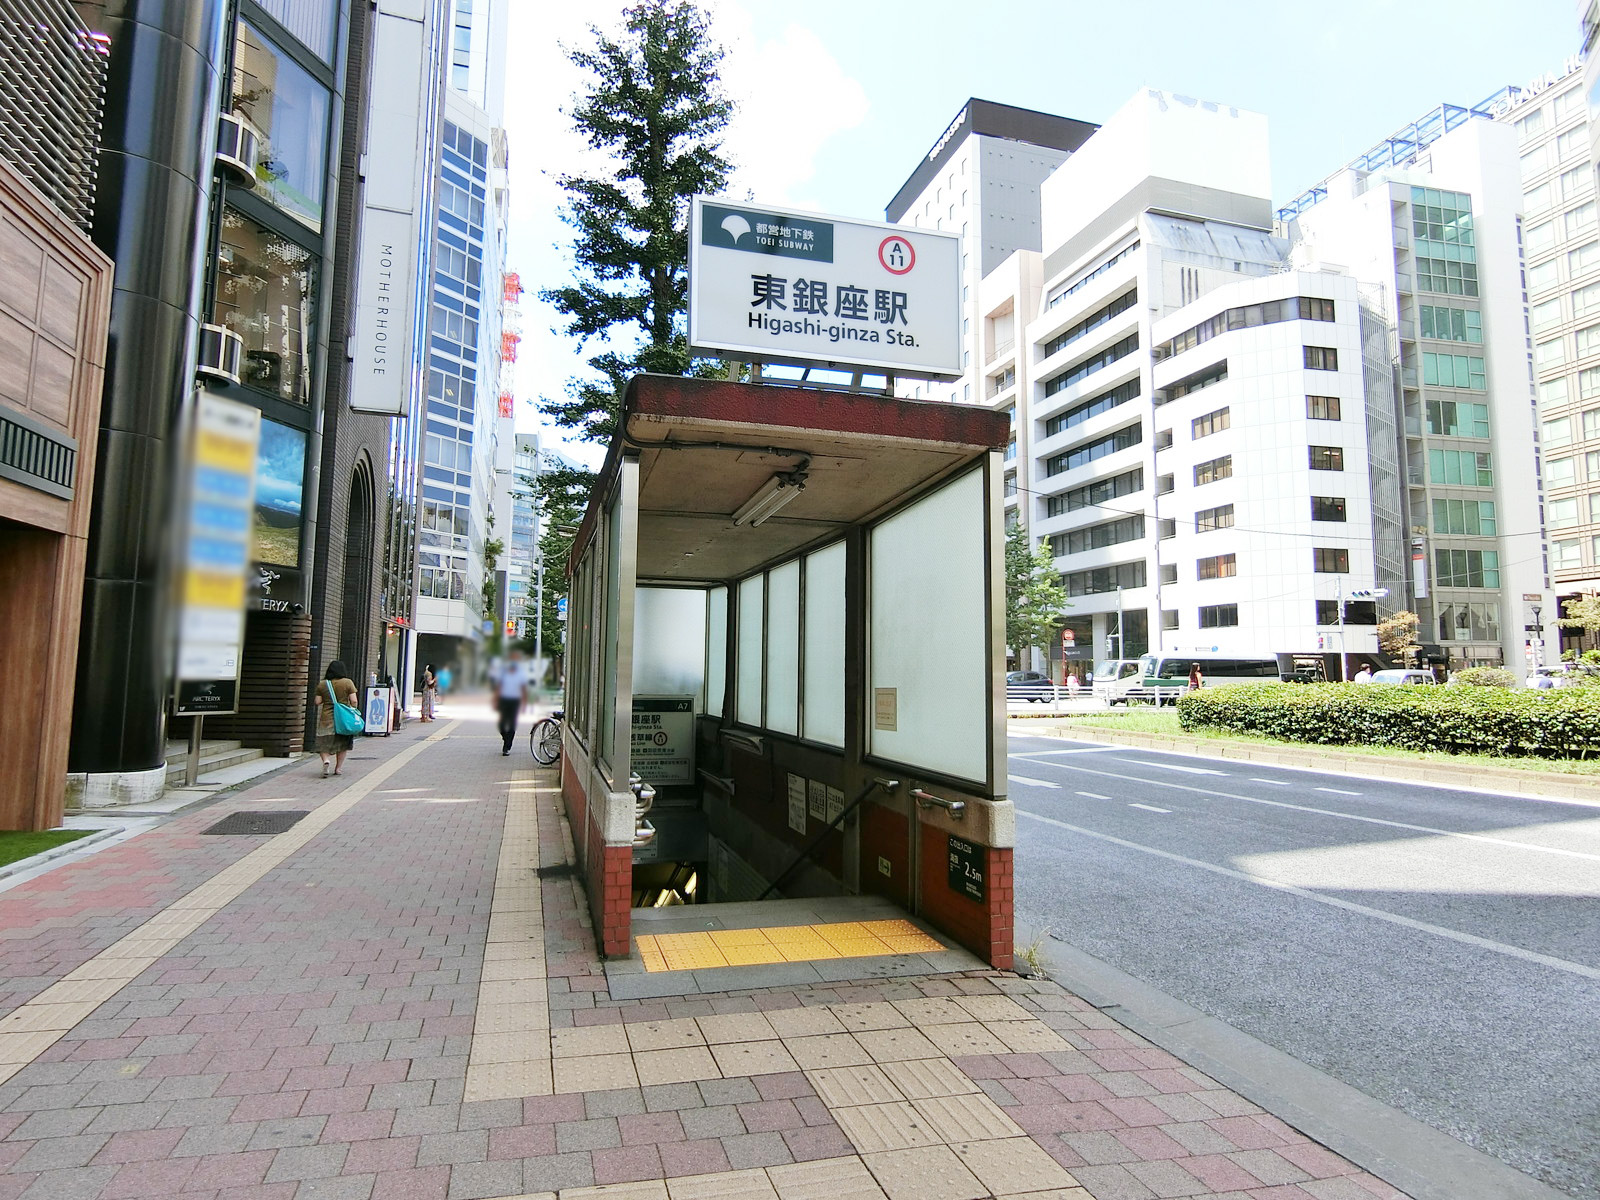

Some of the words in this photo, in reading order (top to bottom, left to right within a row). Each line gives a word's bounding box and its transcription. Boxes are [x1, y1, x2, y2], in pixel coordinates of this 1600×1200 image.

[756, 222, 814, 241] 都営地下鉄
[756, 236, 775, 246] TOEI
[778, 239, 814, 251] SUBWAY
[892, 242, 902, 253] A
[889, 254, 904, 267] 11
[373, 244, 393, 375] MOTHERHOUSE
[750, 273, 908, 326] 東銀座駅
[748, 311, 880, 343] Higashi-ginza
[886, 328, 920, 348] Sta.
[964, 861, 982, 882] 2.5m
